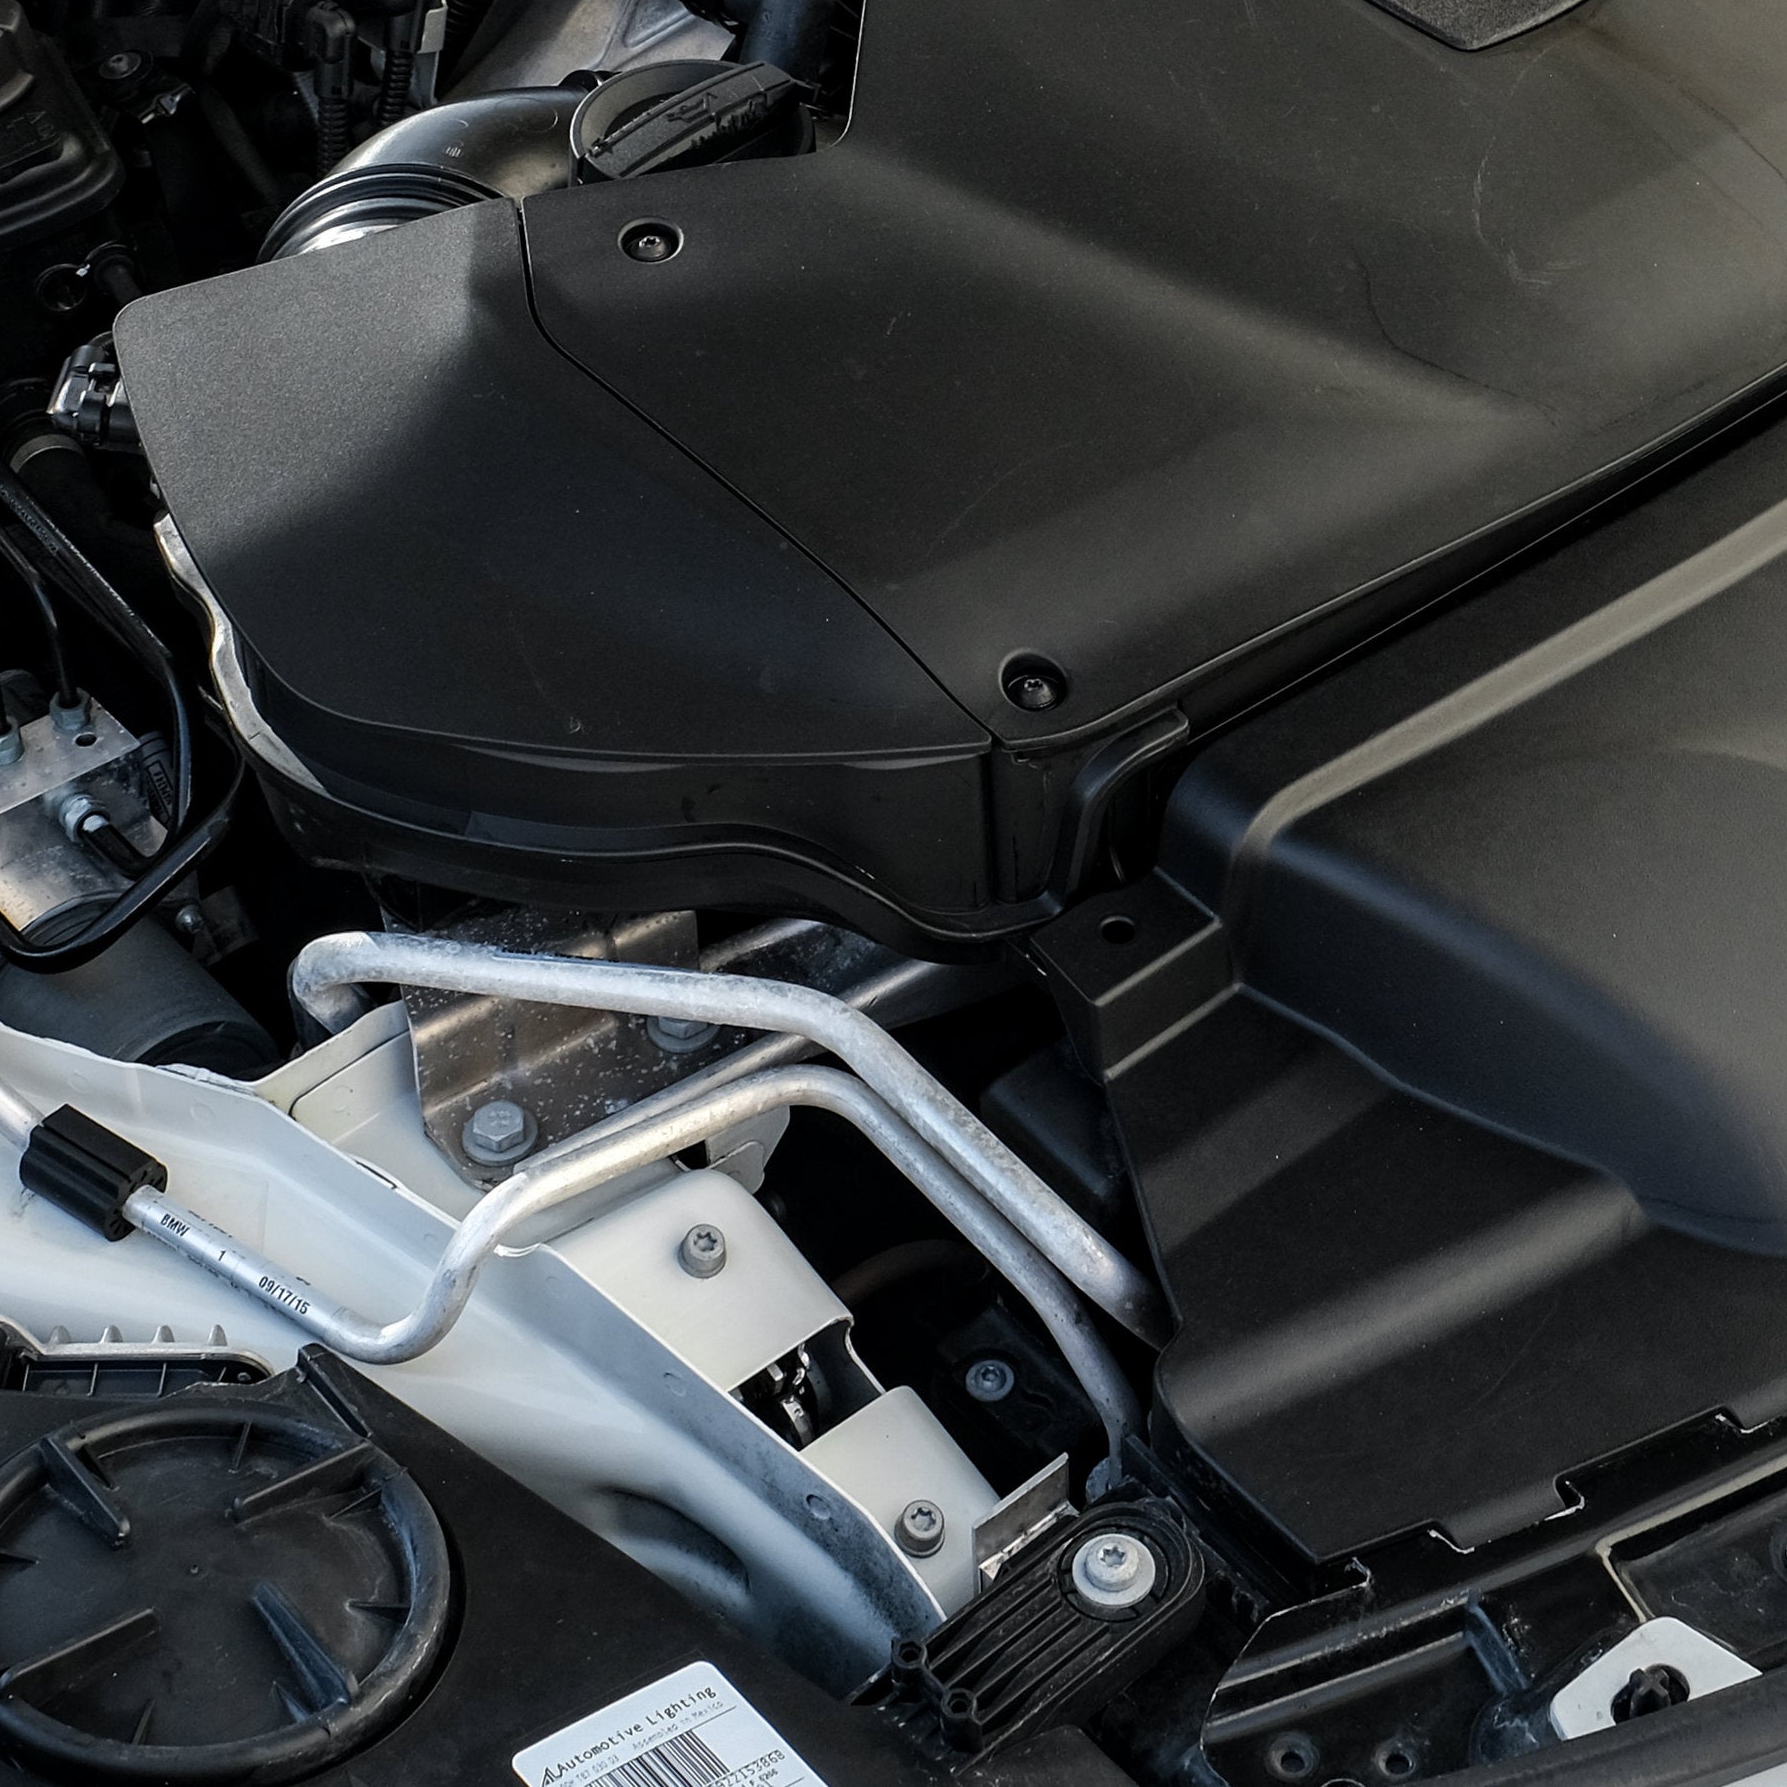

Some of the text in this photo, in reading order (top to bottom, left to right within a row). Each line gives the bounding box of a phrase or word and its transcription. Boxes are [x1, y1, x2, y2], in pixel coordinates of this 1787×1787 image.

[160, 1213, 191, 1238] BMW
[218, 1250, 227, 1262] 1
[258, 1275, 311, 1315] 09/17/15
[554, 1722, 644, 1778] Automotive
[645, 1686, 717, 1725] Lighting
